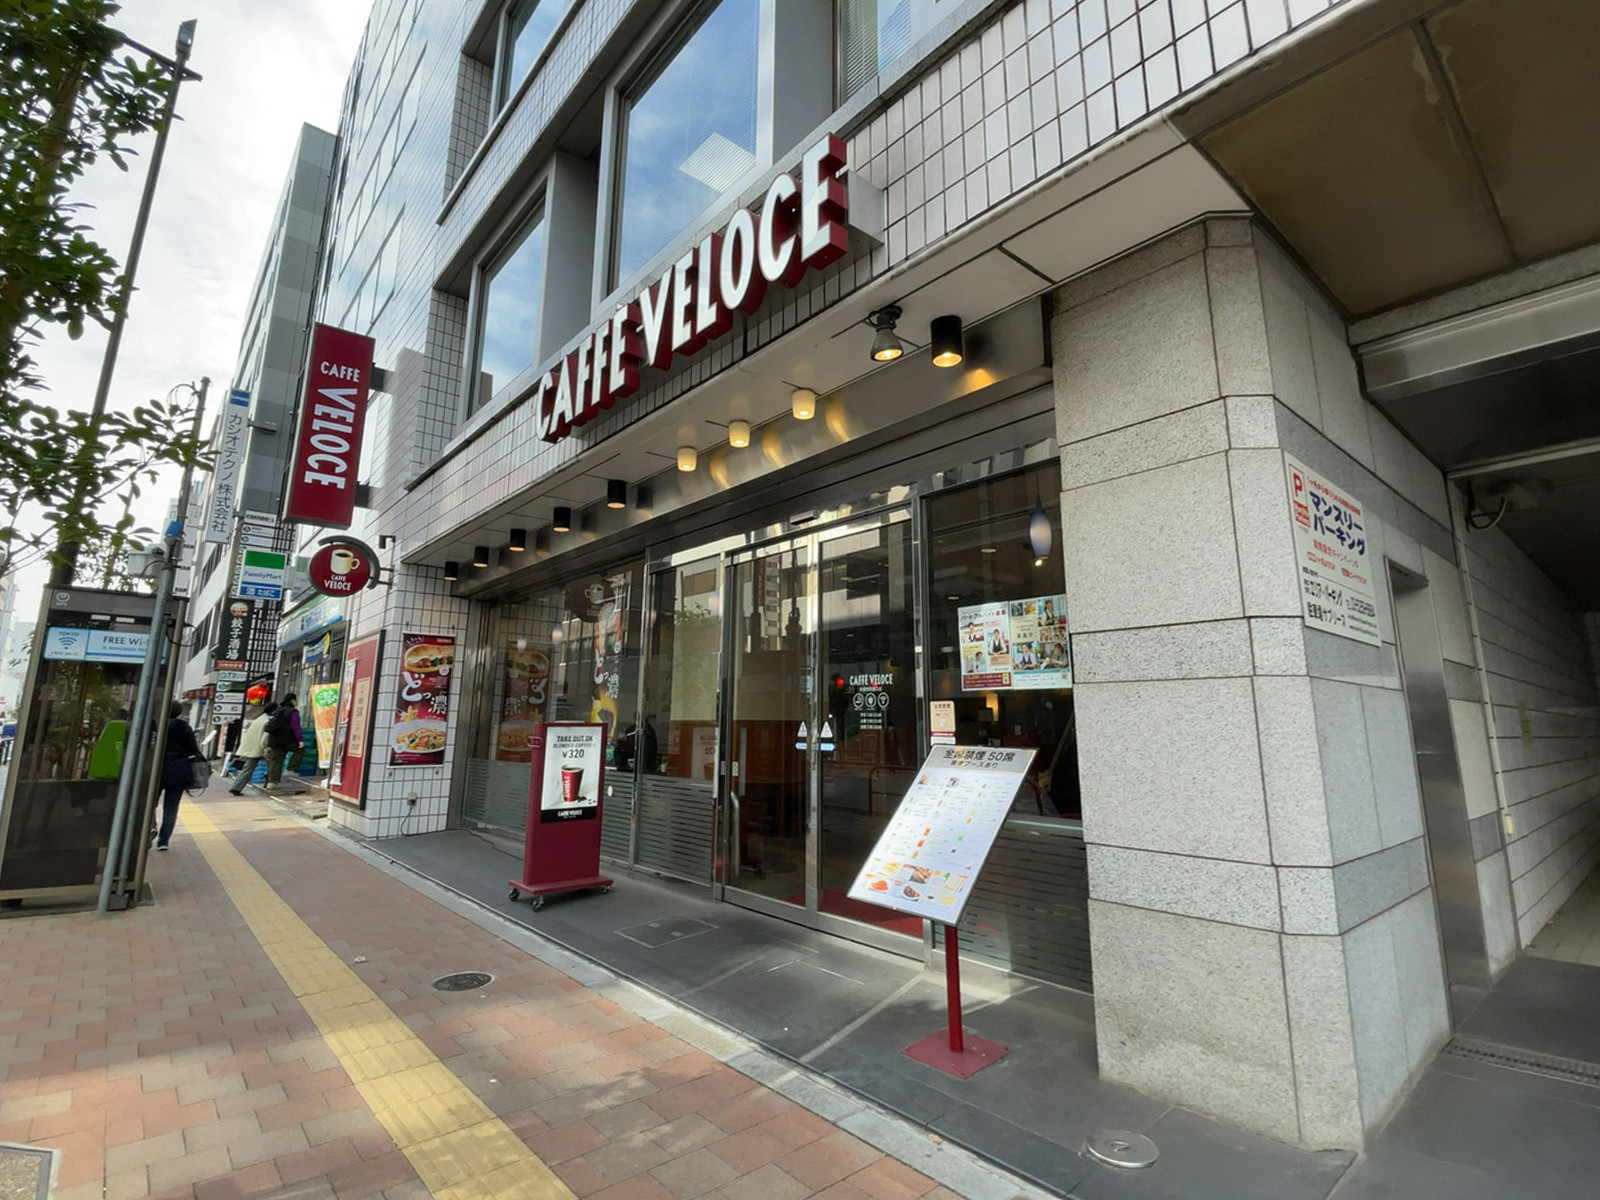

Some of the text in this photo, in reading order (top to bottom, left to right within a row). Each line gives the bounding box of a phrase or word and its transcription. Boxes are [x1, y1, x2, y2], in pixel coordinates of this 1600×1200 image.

[638, 133, 845, 369] VELOCE
[304, 388, 358, 489] VELOCE
[211, 413, 243, 533] カシオテクノ株式会社
[1293, 473, 1303, 497] P
[1309, 490, 1363, 531] マンスリー
[1313, 513, 1365, 556] パーキング
[244, 569, 282, 580] FamilyMart
[323, 579, 351, 591] VELOCE
[103, 636, 147, 646] FREE Wi-
[869, 673, 893, 685] VELOCE
